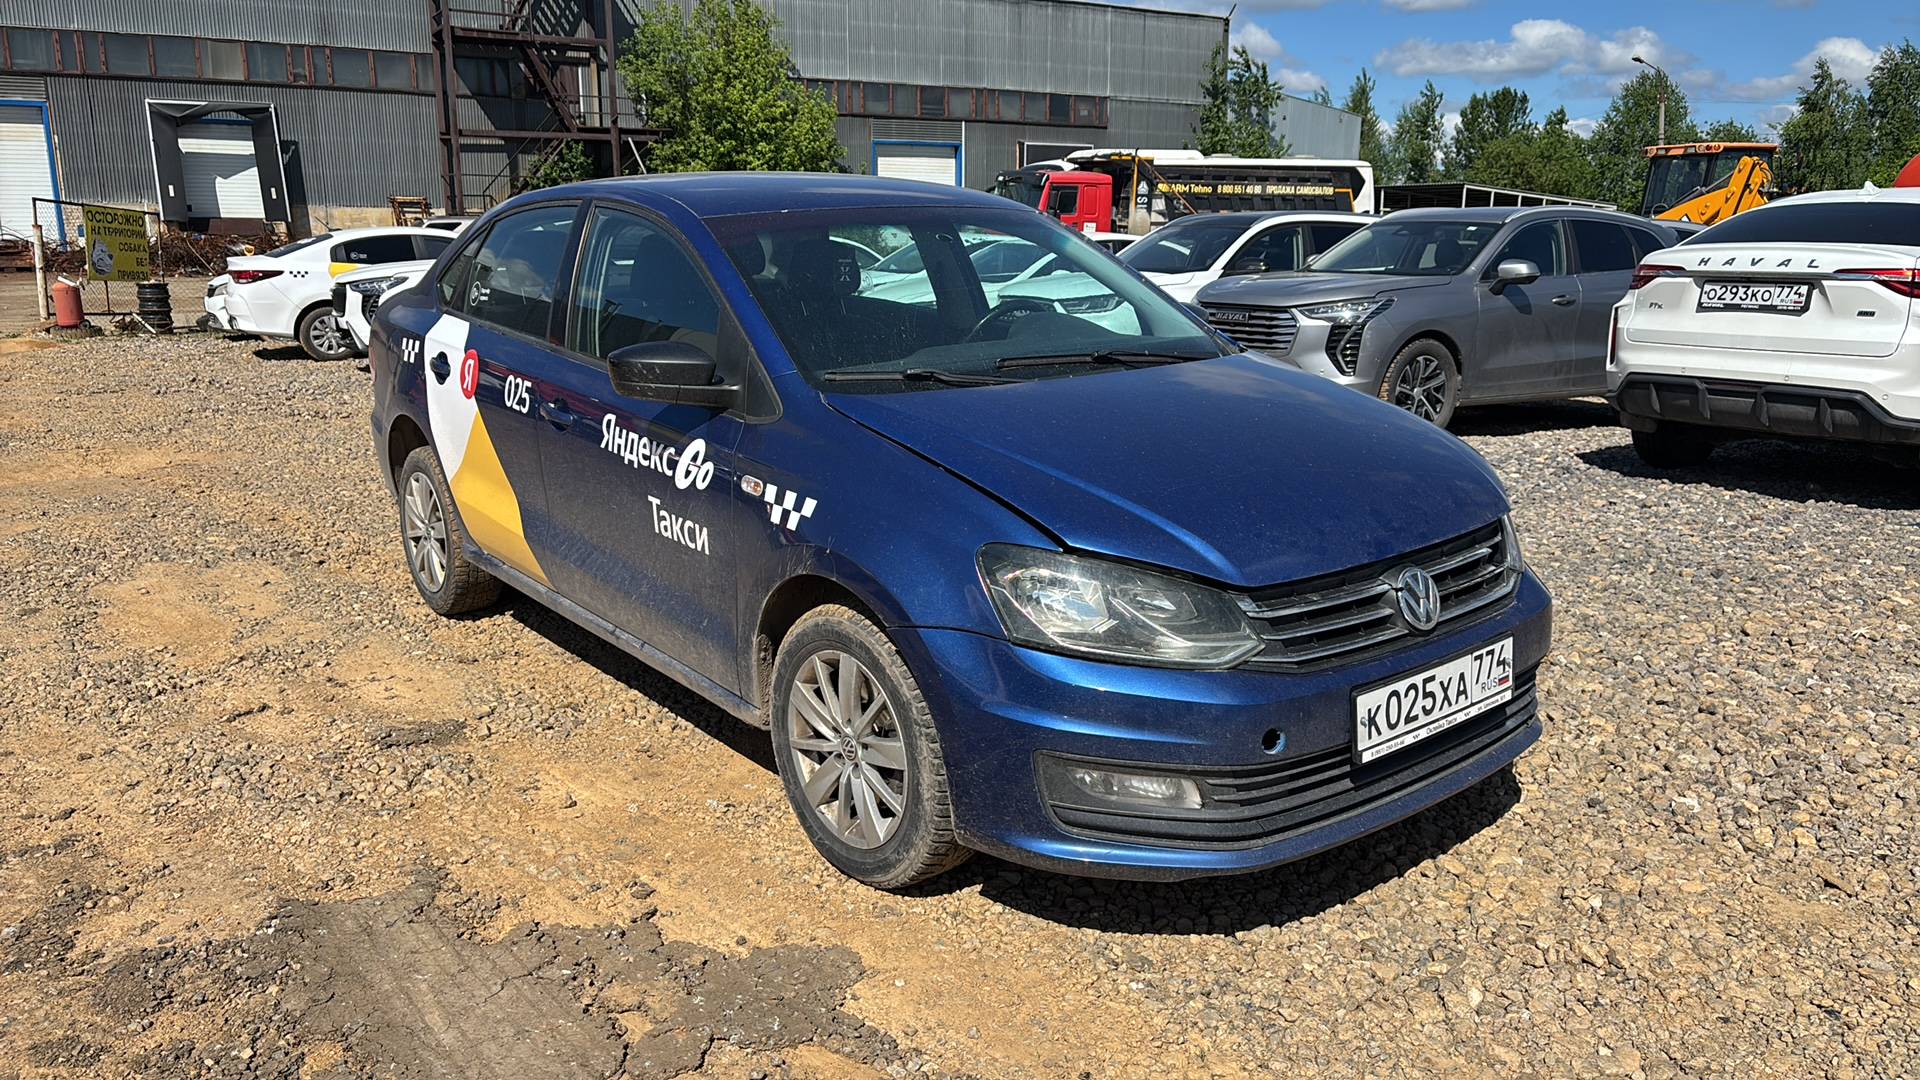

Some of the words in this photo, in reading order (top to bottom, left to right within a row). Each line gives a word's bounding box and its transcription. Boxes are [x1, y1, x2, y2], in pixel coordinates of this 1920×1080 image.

[1190, 183, 1213, 193] Tehno
[1266, 185, 1295, 194] ПРОДАЖА
[1296, 186, 1335, 195] САМОСВАЛОВ
[86, 210, 144, 227] ОСТОРОЖНО
[91, 225, 102, 236] НА
[118, 242, 147, 253] СОБАКА
[1697, 257, 1820, 268] HAVAL
[1707, 285, 1772, 302] О293КО
[1776, 285, 1802, 299] 774
[1216, 312, 1246, 320] HAVAL
[464, 358, 476, 392] Я
[504, 374, 532, 414] 025
[600, 413, 676, 476] Яндекс
[675, 438, 714, 490] Go
[648, 495, 710, 555] Такси
[1367, 671, 1469, 741] К025ХА
[1473, 644, 1506, 686] 774
[1481, 677, 1498, 694] RUS
